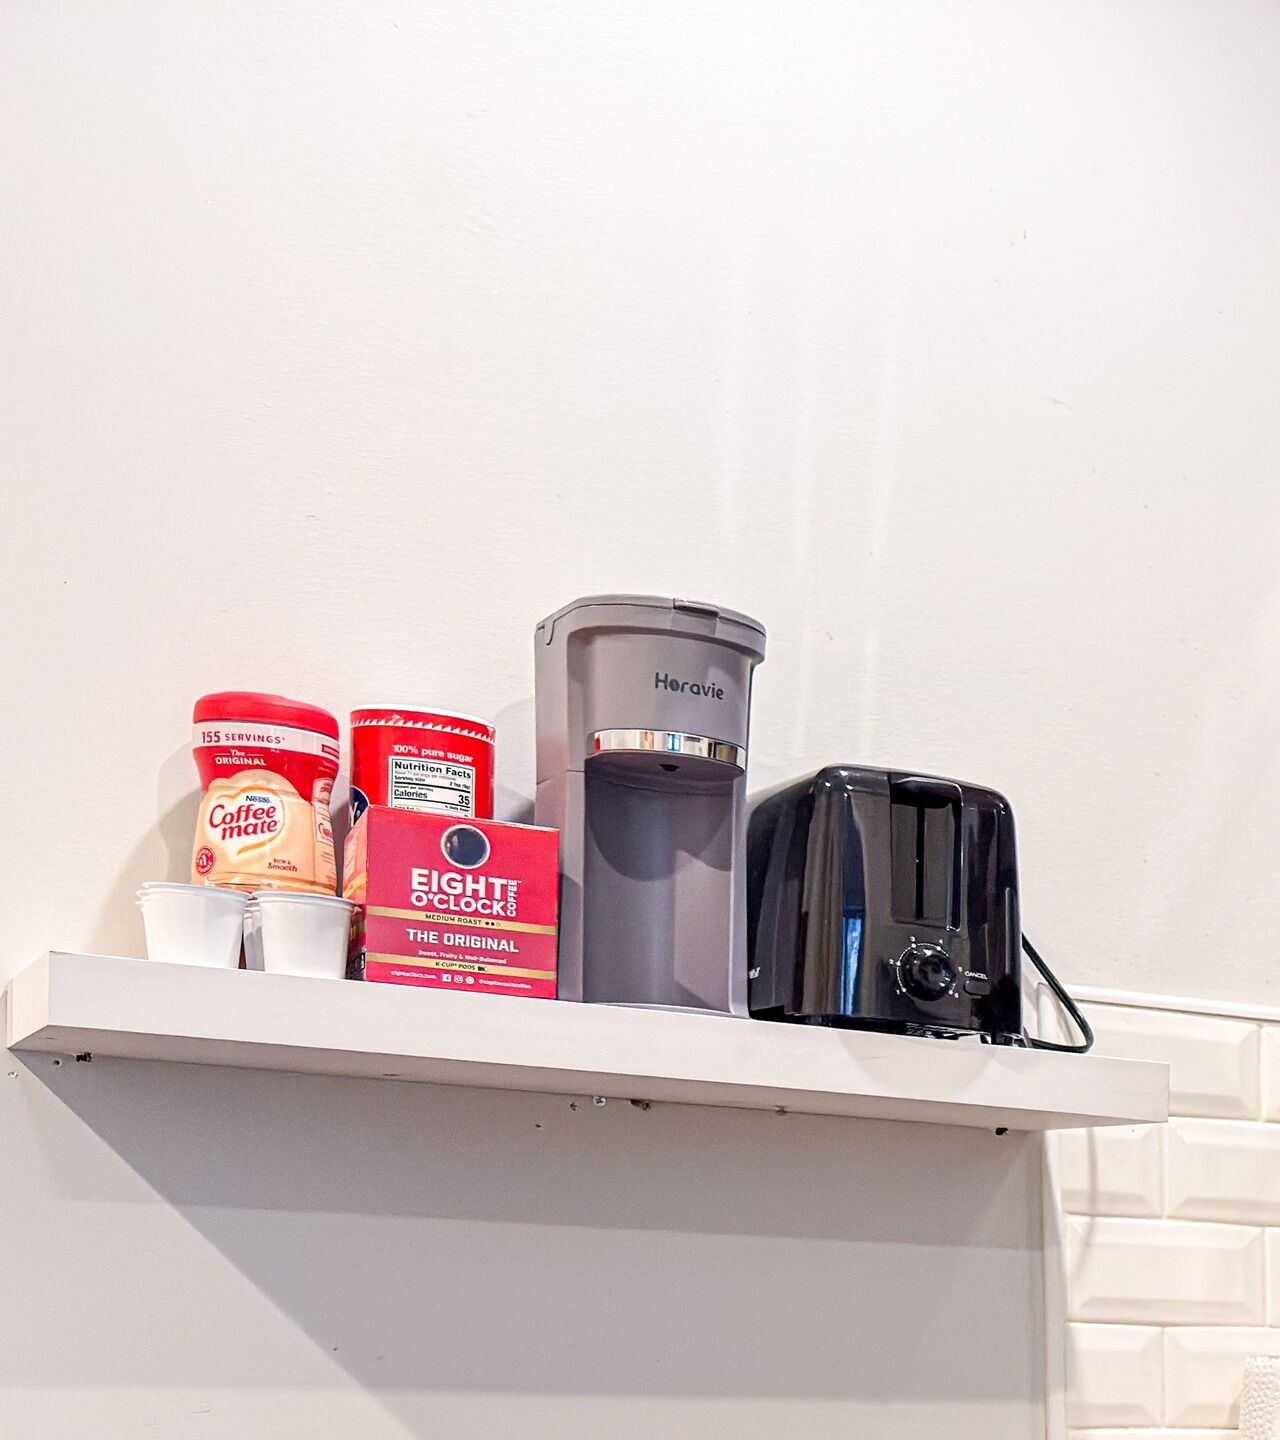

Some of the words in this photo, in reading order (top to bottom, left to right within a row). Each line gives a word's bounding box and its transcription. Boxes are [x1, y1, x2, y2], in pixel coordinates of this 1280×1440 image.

[201, 731, 221, 744] 155
[215, 756, 267, 766] ORIGINAL
[230, 749, 246, 757] The
[393, 745, 419, 755] 100%
[421, 748, 445, 759] pure
[447, 752, 474, 763] sugar
[394, 761, 442, 774] Nutrition
[446, 767, 472, 779] Facts
[394, 789, 428, 799] Calories
[458, 794, 470, 806] 35
[209, 804, 276, 828] Coffee
[221, 820, 277, 841] mate
[267, 862, 298, 873] Smooth
[411, 867, 508, 900] EIGHT
[410, 891, 507, 917] O'CLOCK
[507, 879, 517, 917] COFFEE
[425, 914, 455, 923] MEDIUM
[457, 917, 482, 926] ROAST
[406, 928, 439, 944] THE
[443, 932, 520, 953] ORIGINAL
[458, 963, 476, 971] PODS
[965, 970, 988, 980] CANCEL
